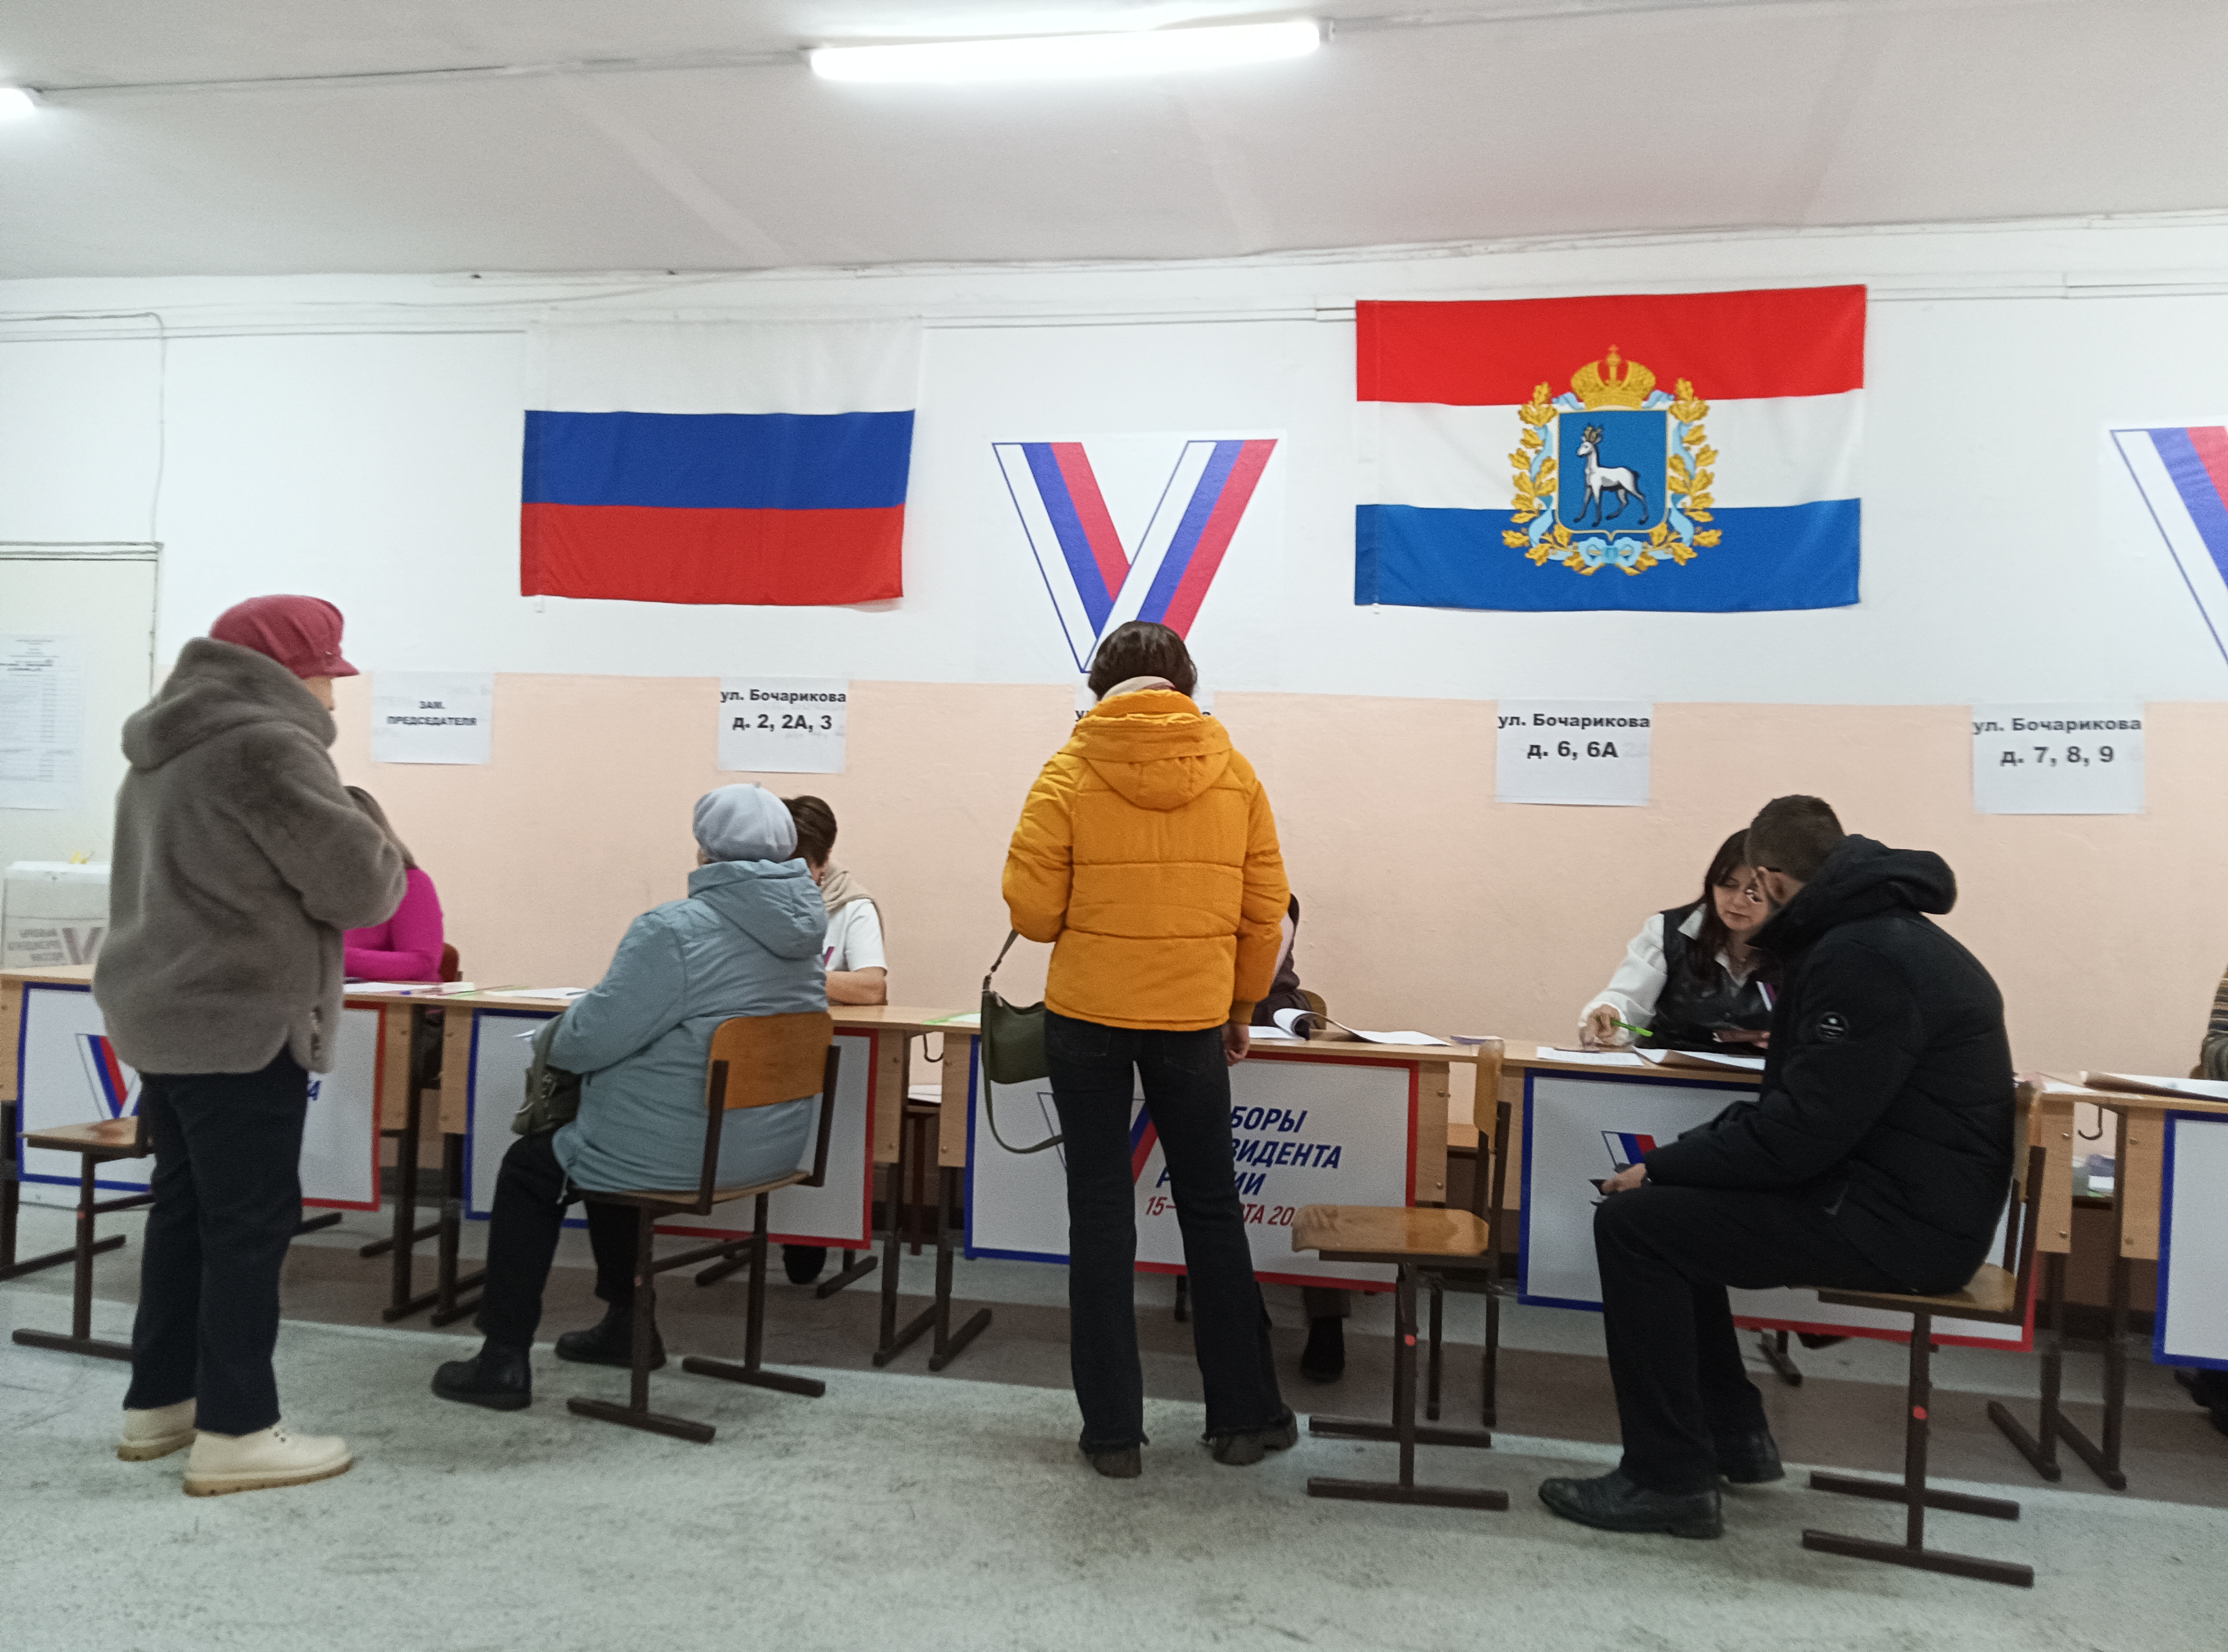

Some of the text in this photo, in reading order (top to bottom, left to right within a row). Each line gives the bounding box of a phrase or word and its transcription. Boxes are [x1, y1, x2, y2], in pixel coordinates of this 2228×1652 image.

[720, 688, 847, 704] ул. Бочарикова
[386, 716, 478, 726] ПРЕДСЕДАТЕЛЯ
[732, 717, 751, 731] д.
[757, 714, 775, 732] 2,
[820, 715, 832, 730] 3
[1497, 713, 1651, 730] ул. Бочарикова
[1972, 717, 2142, 735] ул. Бочарикова
[1526, 744, 1548, 759] д.
[1557, 741, 1578, 760] 6,
[2000, 746, 2115, 767] д. 7, 8, 9
[1231, 1106, 1308, 1133] БОРЫ
